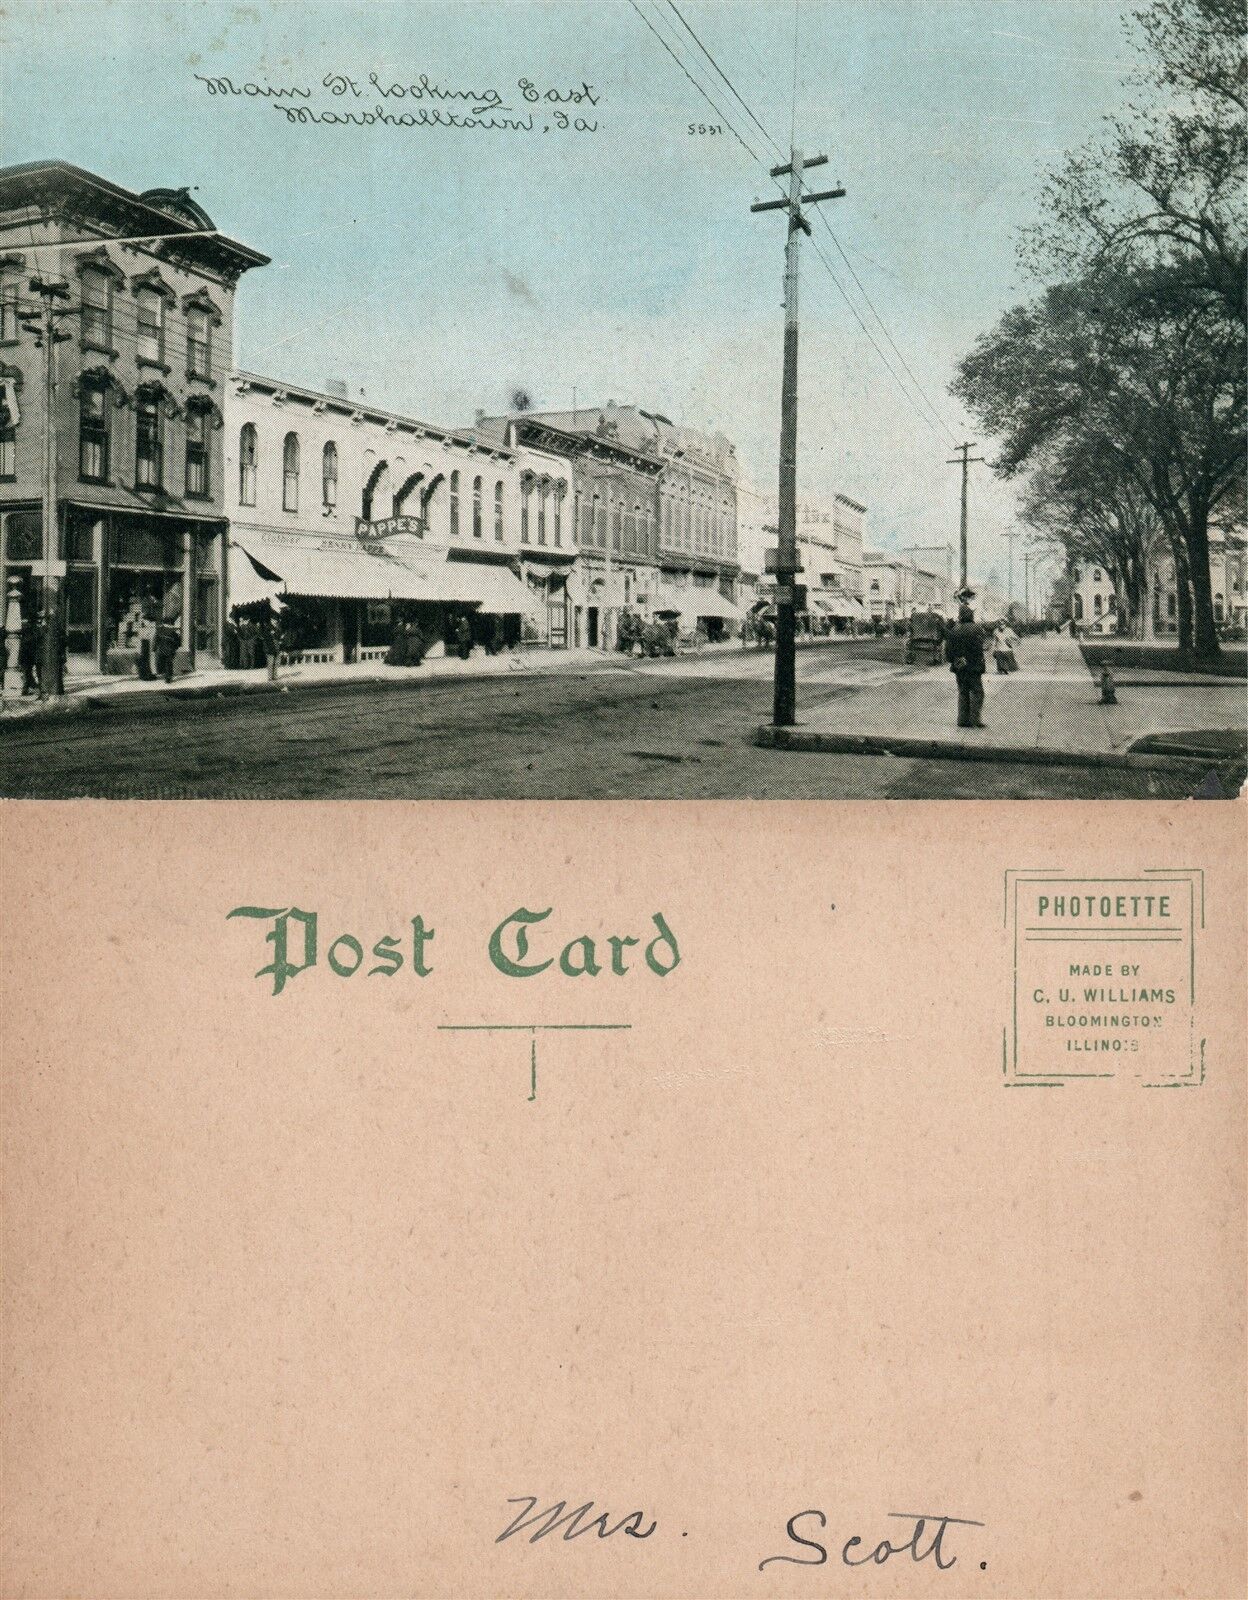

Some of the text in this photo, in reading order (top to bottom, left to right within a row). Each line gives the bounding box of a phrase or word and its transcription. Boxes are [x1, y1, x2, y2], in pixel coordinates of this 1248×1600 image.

[1038, 896, 1171, 918] PHOTOETTE
[225, 906, 682, 997] Post Card
[1069, 965, 1140, 976] MADE BY
[1059, 989, 1076, 1003] U.
[1084, 989, 1176, 1004] WILLIAMS
[1046, 1016, 1162, 1027] BLOOMINGTON
